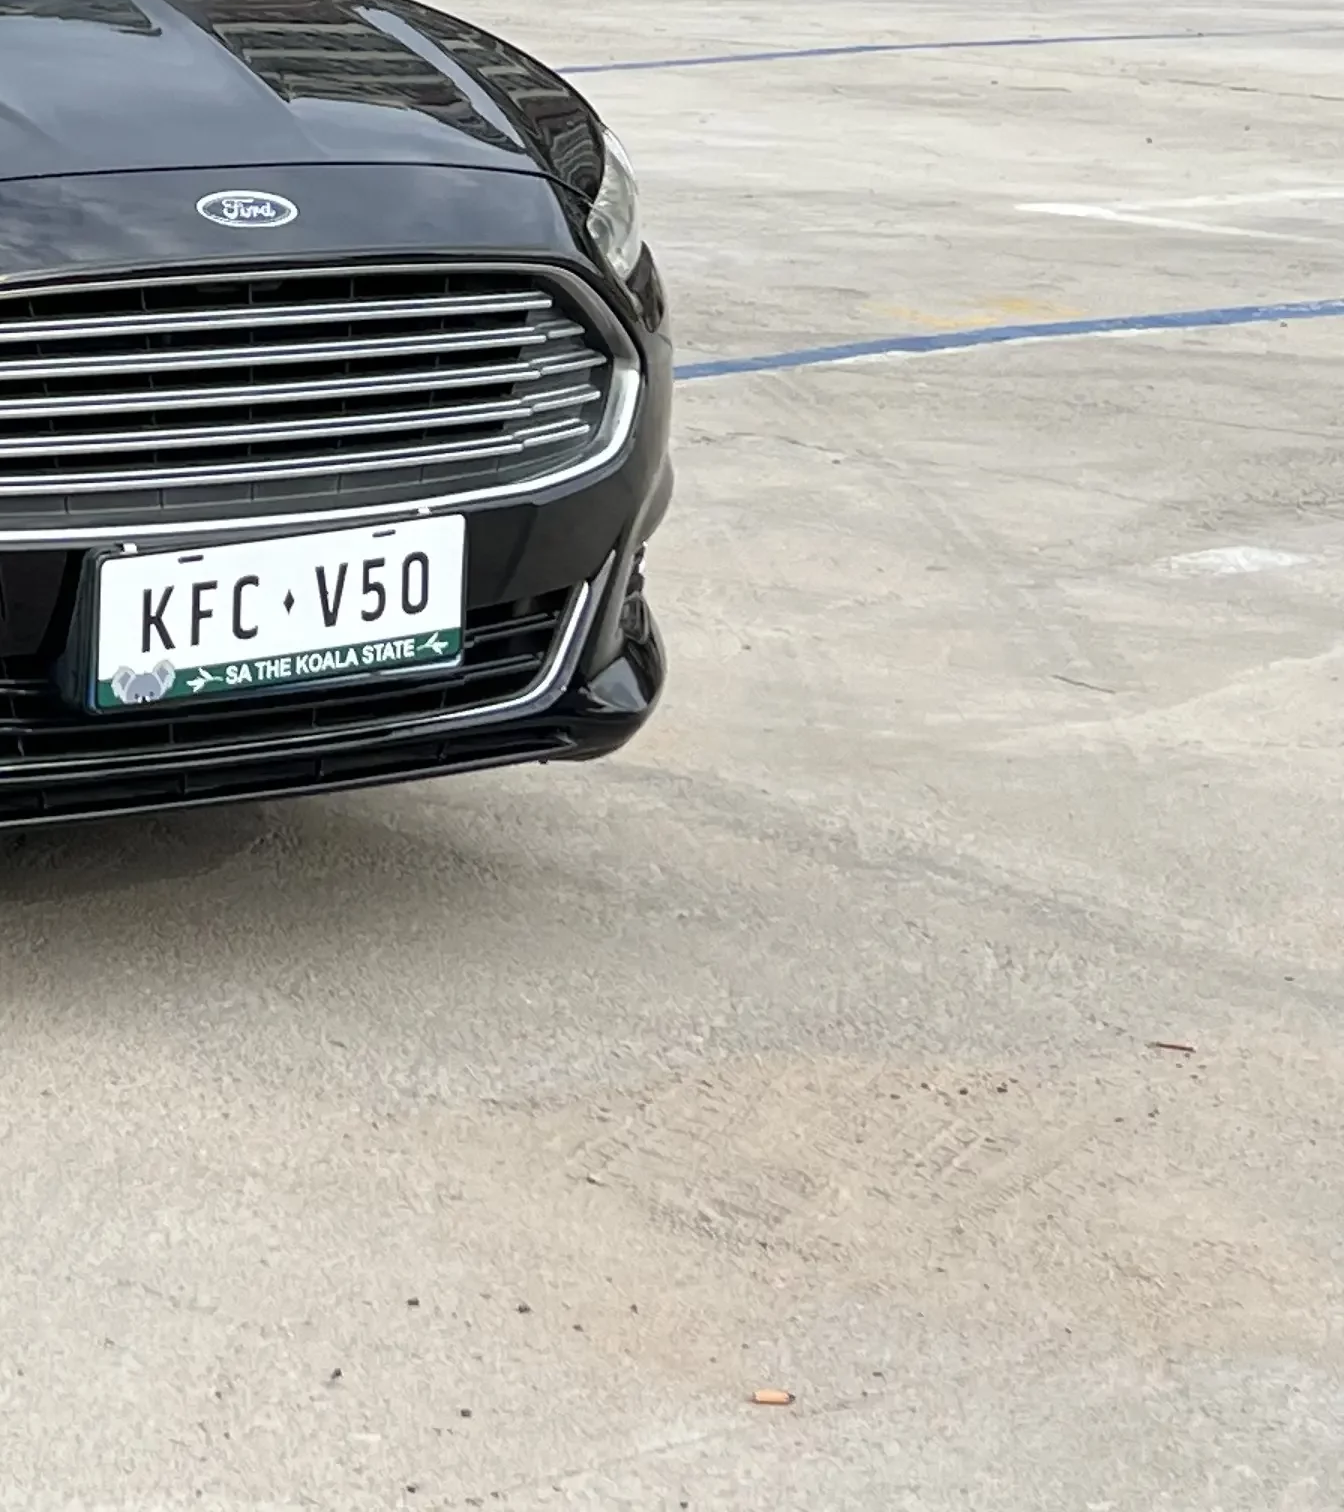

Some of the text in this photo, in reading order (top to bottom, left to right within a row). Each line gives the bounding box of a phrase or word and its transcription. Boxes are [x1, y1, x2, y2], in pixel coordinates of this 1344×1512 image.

[222, 199, 276, 219] Ford
[226, 639, 415, 685] SA THE KOALA STATE
